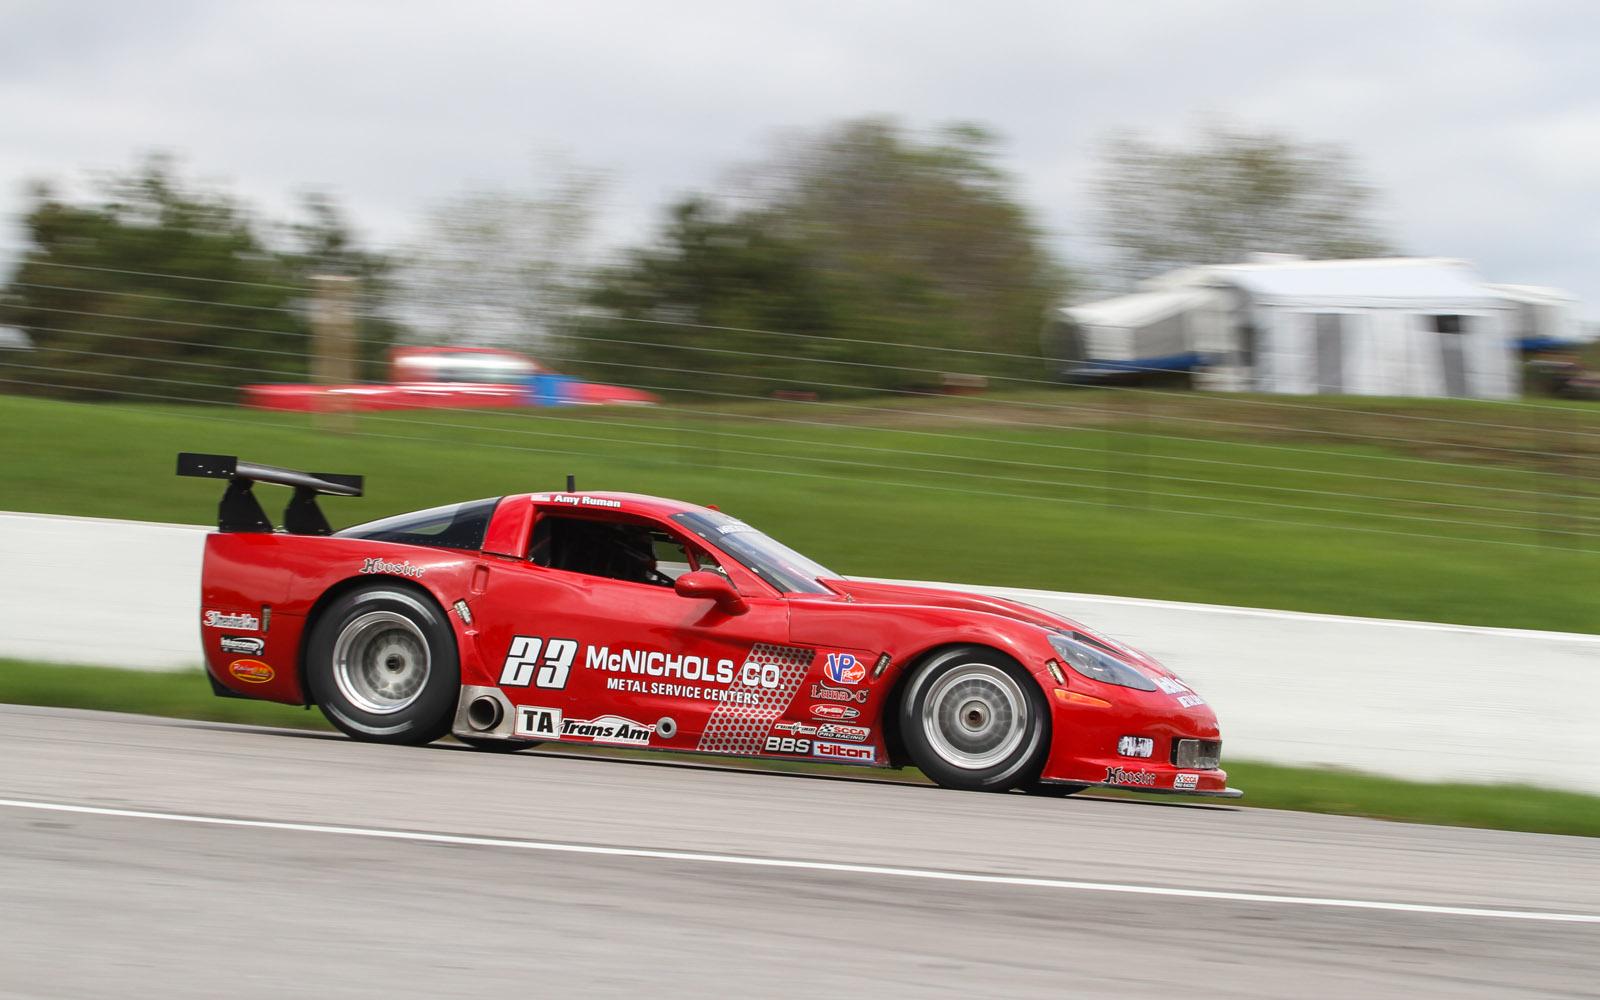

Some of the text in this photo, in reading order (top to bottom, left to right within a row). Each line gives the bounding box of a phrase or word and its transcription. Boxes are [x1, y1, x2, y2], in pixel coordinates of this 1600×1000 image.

[554, 495, 621, 508] Amy Ruman
[359, 558, 426, 578] Hoosier
[498, 634, 578, 690] 23
[585, 645, 785, 690] McNICHOLS CO.
[827, 653, 856, 683] VP
[607, 678, 759, 705] METAL SERVICE CENTERS
[523, 710, 554, 734] TA
[561, 720, 613, 736] Trans
[614, 724, 650, 741] Am
[833, 726, 866, 736] SCCA
[764, 736, 811, 753] BBS
[835, 733, 865, 741] RACING
[817, 743, 871, 759] tilton
[1102, 766, 1157, 785] Hoosier
